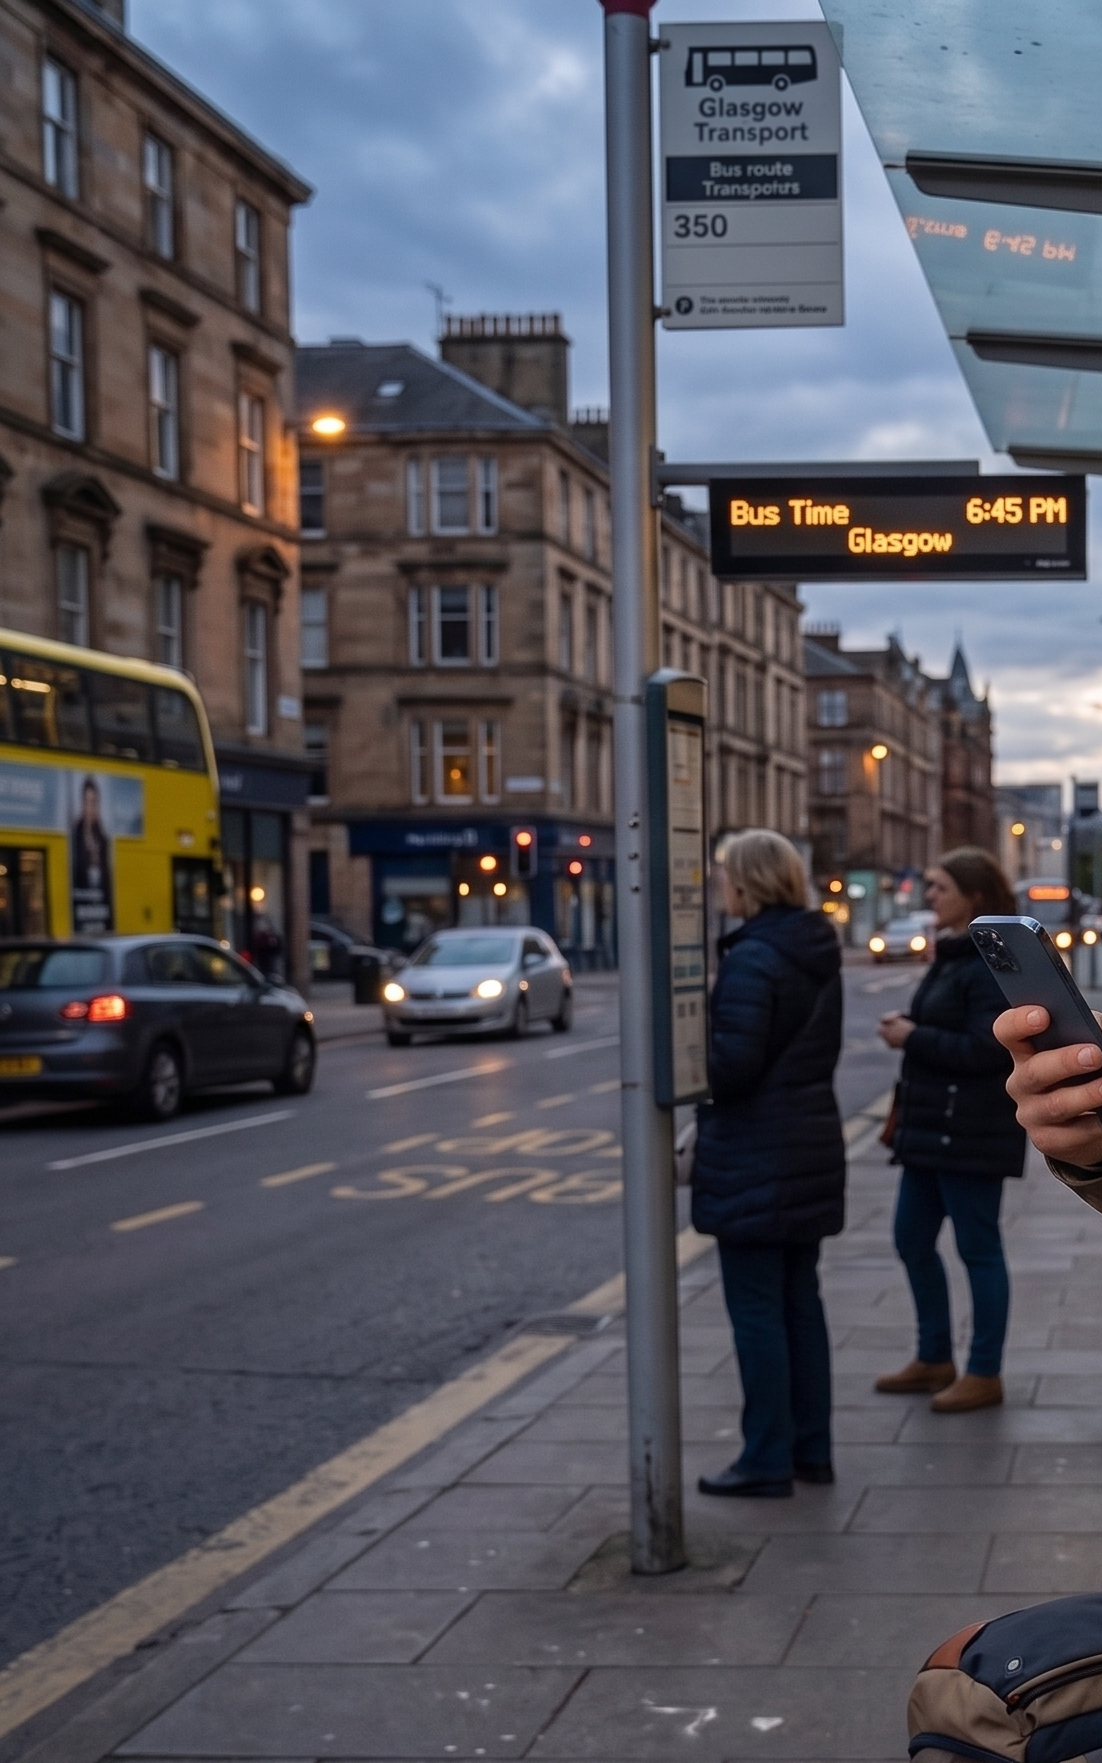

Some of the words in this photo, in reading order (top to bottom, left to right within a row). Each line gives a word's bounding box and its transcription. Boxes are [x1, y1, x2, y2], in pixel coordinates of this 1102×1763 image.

[698, 97, 803, 122] Glasgow
[693, 122, 809, 146] Transport
[709, 161, 742, 178] Bus
[746, 160, 794, 177] route
[673, 213, 729, 239] 350
[729, 499, 781, 526] Bus
[788, 498, 850, 526] Time
[965, 497, 1023, 525] 6:45
[1028, 497, 1068, 524] PM
[847, 527, 953, 557] Glasgow
